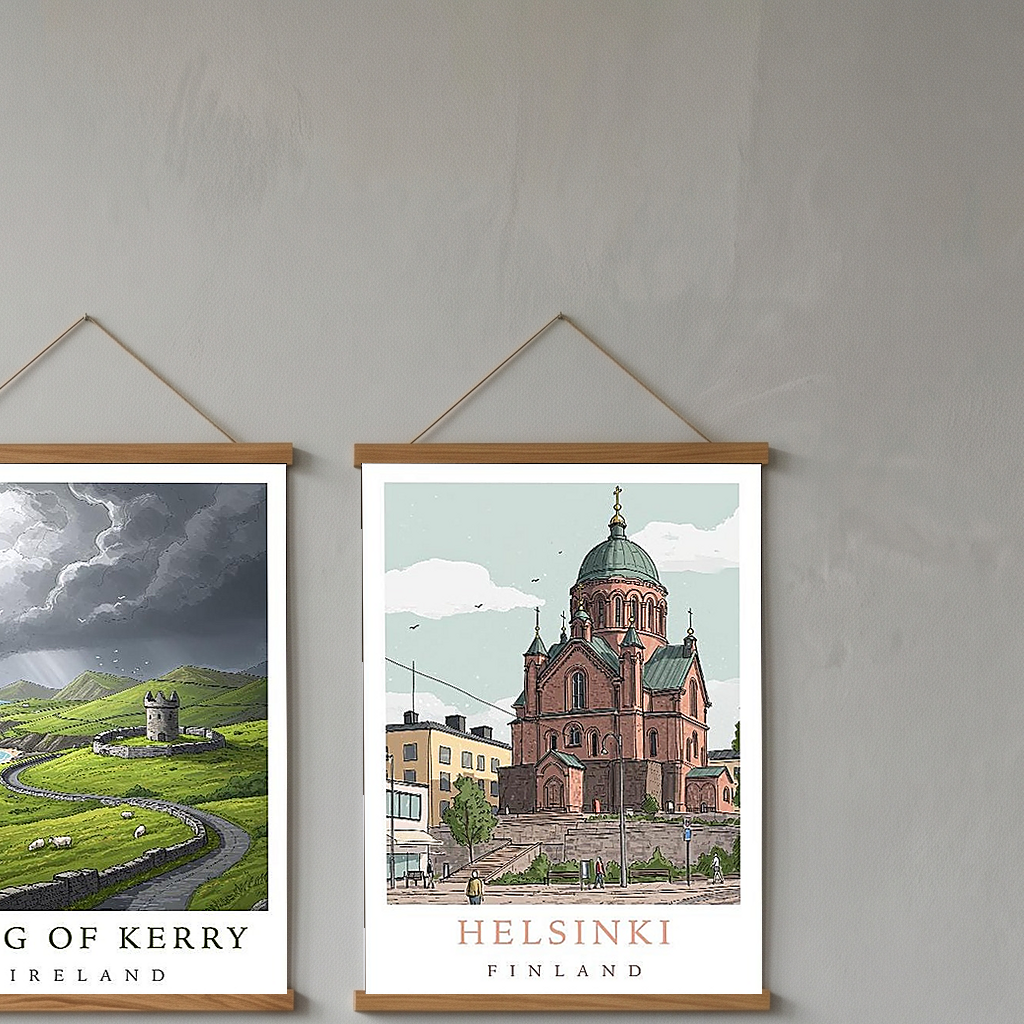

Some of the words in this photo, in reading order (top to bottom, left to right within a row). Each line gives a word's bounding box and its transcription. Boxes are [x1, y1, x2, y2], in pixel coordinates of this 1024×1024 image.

[49, 926, 98, 950] OF
[119, 926, 249, 950] KERRY
[457, 919, 670, 945] HELSINKI
[10, 968, 166, 982] IRELAND
[487, 964, 642, 978] FINLAND
